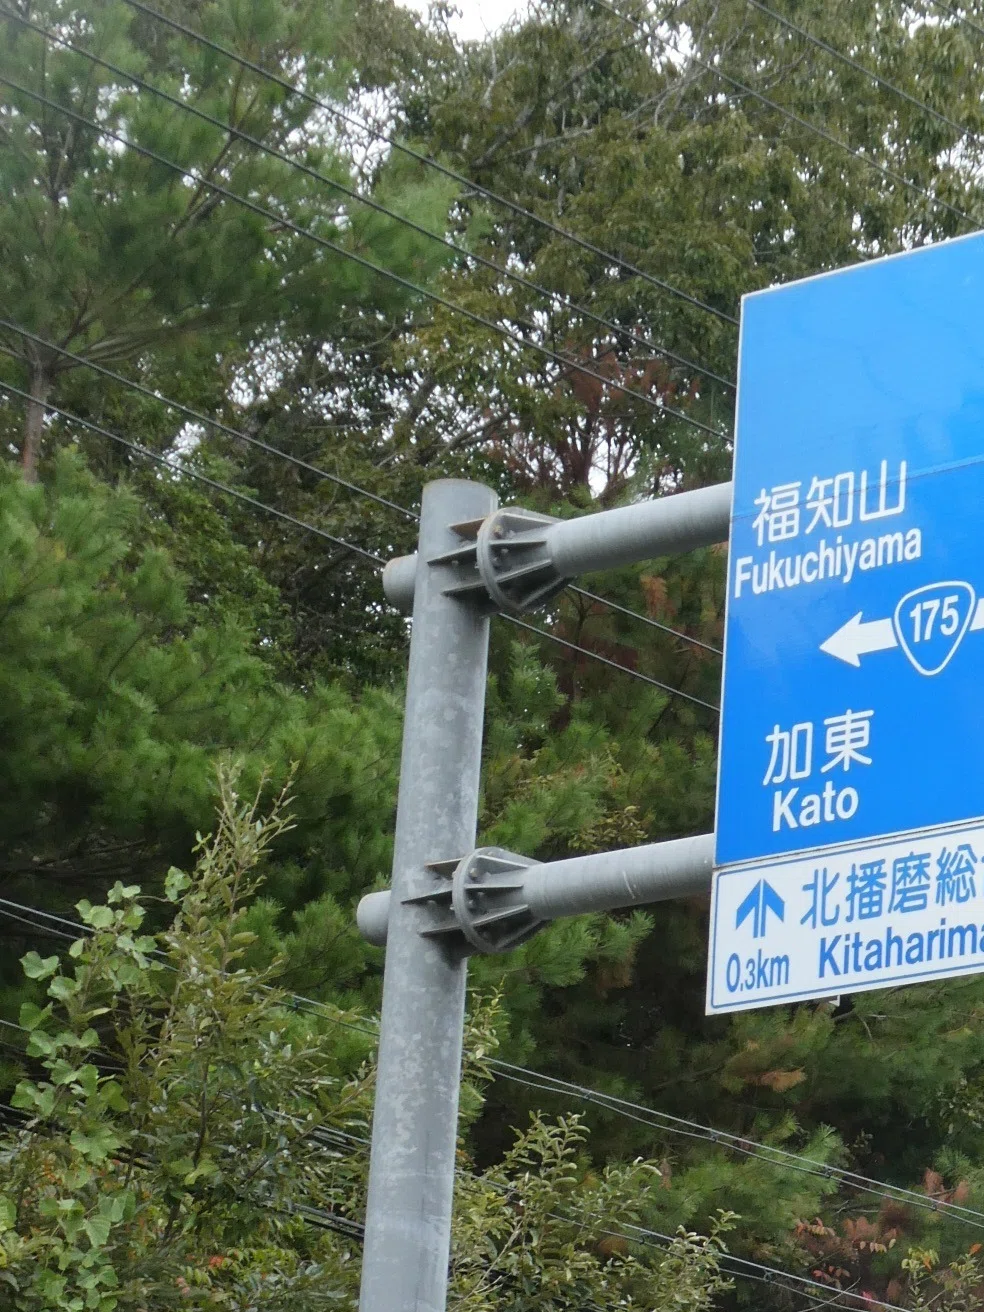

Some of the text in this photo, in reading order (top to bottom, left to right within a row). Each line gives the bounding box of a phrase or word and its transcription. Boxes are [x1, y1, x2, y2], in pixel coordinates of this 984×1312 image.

[751, 459, 908, 548] 福知山
[734, 527, 922, 598] Fukuchiyama
[908, 595, 960, 643] 175
[762, 708, 874, 786] 加東
[772, 780, 859, 832] Kato
[726, 949, 790, 993] 0.3km
